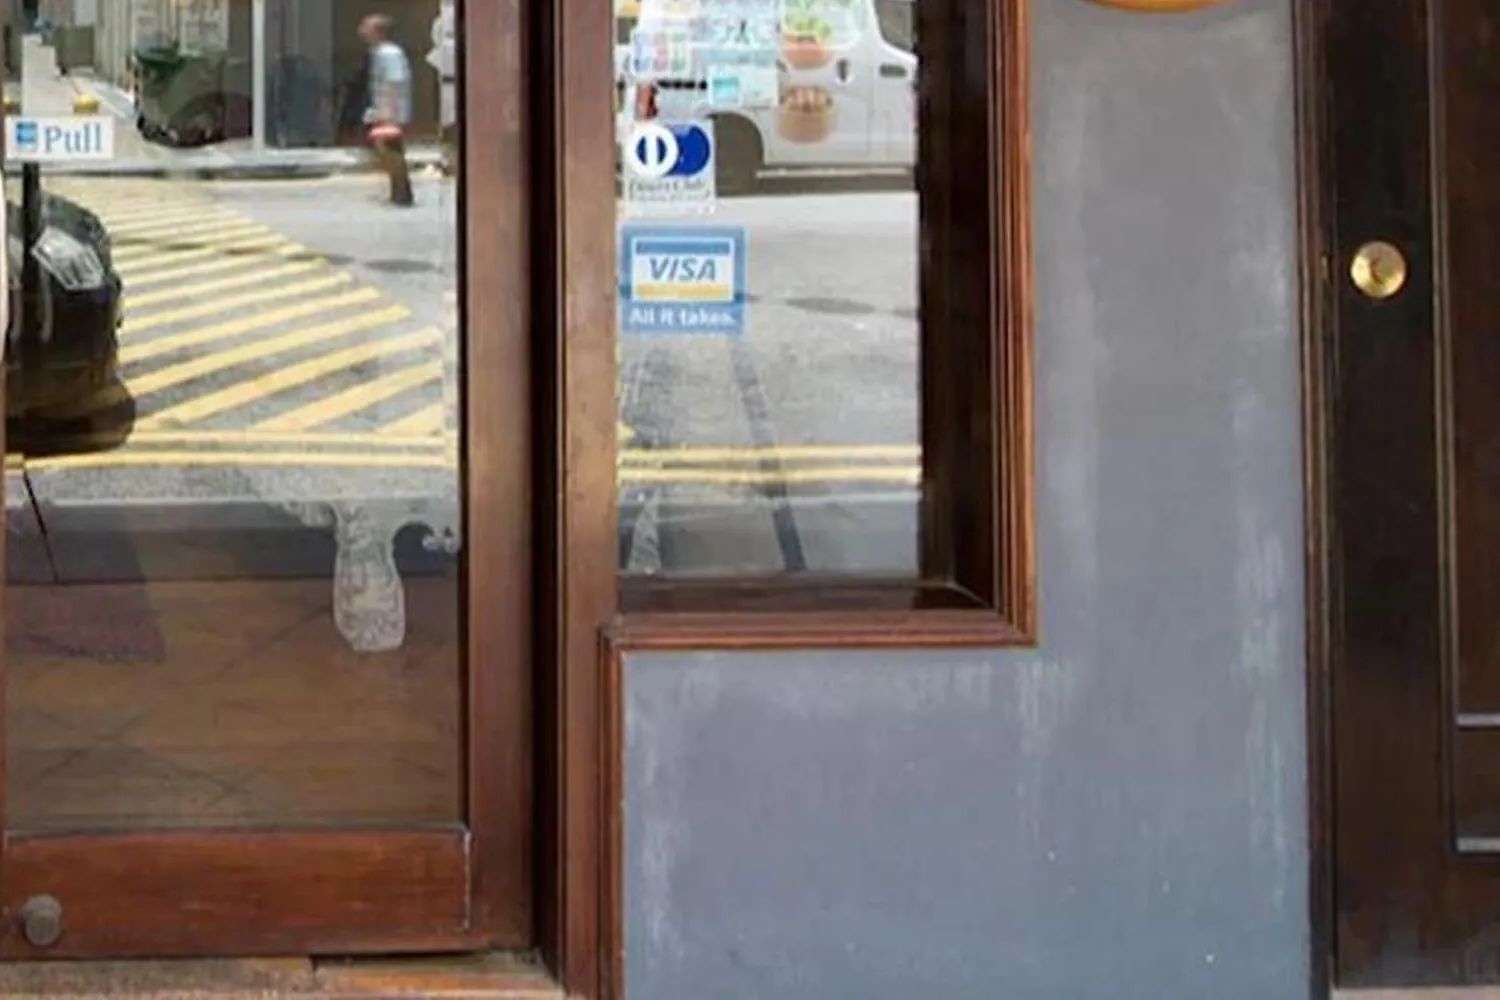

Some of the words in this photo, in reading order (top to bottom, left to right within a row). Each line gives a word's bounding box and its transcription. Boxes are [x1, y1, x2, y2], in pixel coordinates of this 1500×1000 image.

[43, 122, 100, 153] Pull
[649, 257, 717, 281] VISA
[629, 307, 655, 325] All
